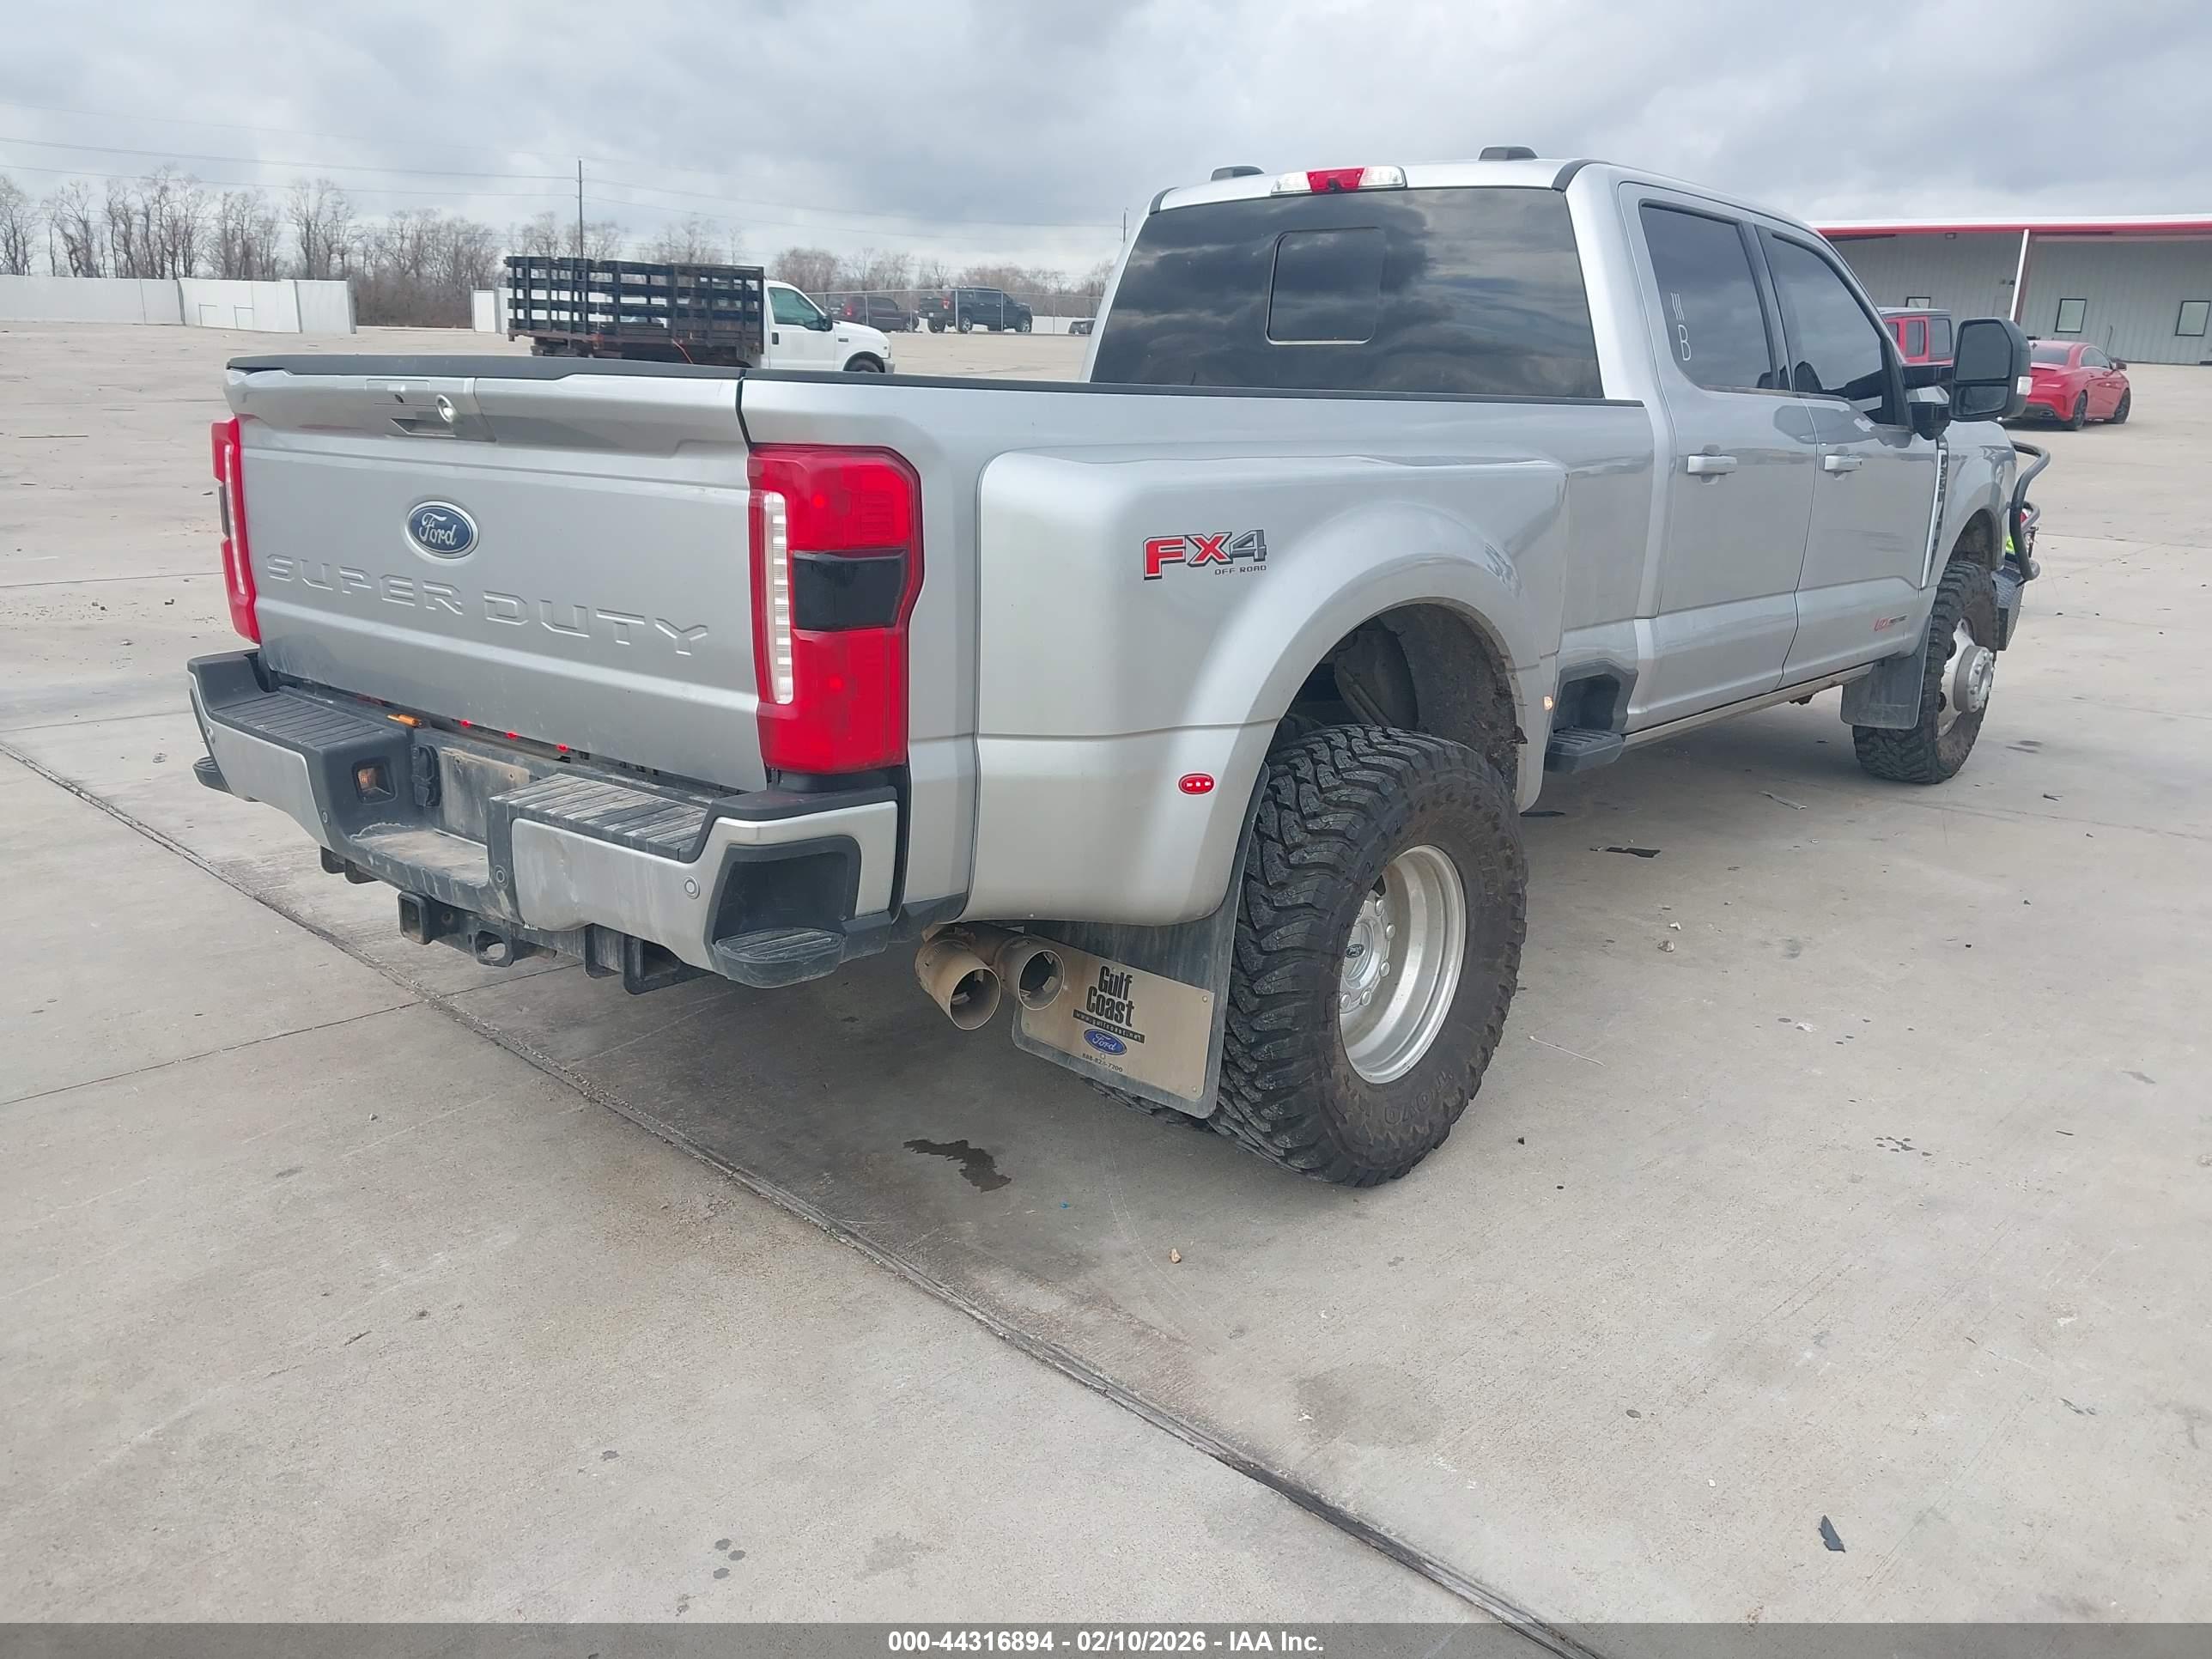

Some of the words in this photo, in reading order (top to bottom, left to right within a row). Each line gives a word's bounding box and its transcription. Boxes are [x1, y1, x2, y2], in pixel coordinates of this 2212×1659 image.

[418, 513, 458, 545] Ford
[1143, 529, 1267, 581] FX4
[1215, 568, 1236, 576] OFF
[1240, 565, 1267, 574] ROAD
[266, 554, 464, 615] SUPER
[483, 589, 709, 656] DUTY
[1098, 966, 1133, 1000] Gulf
[1086, 986, 1134, 1027] Coast
[1092, 1033, 1117, 1051] Ford
